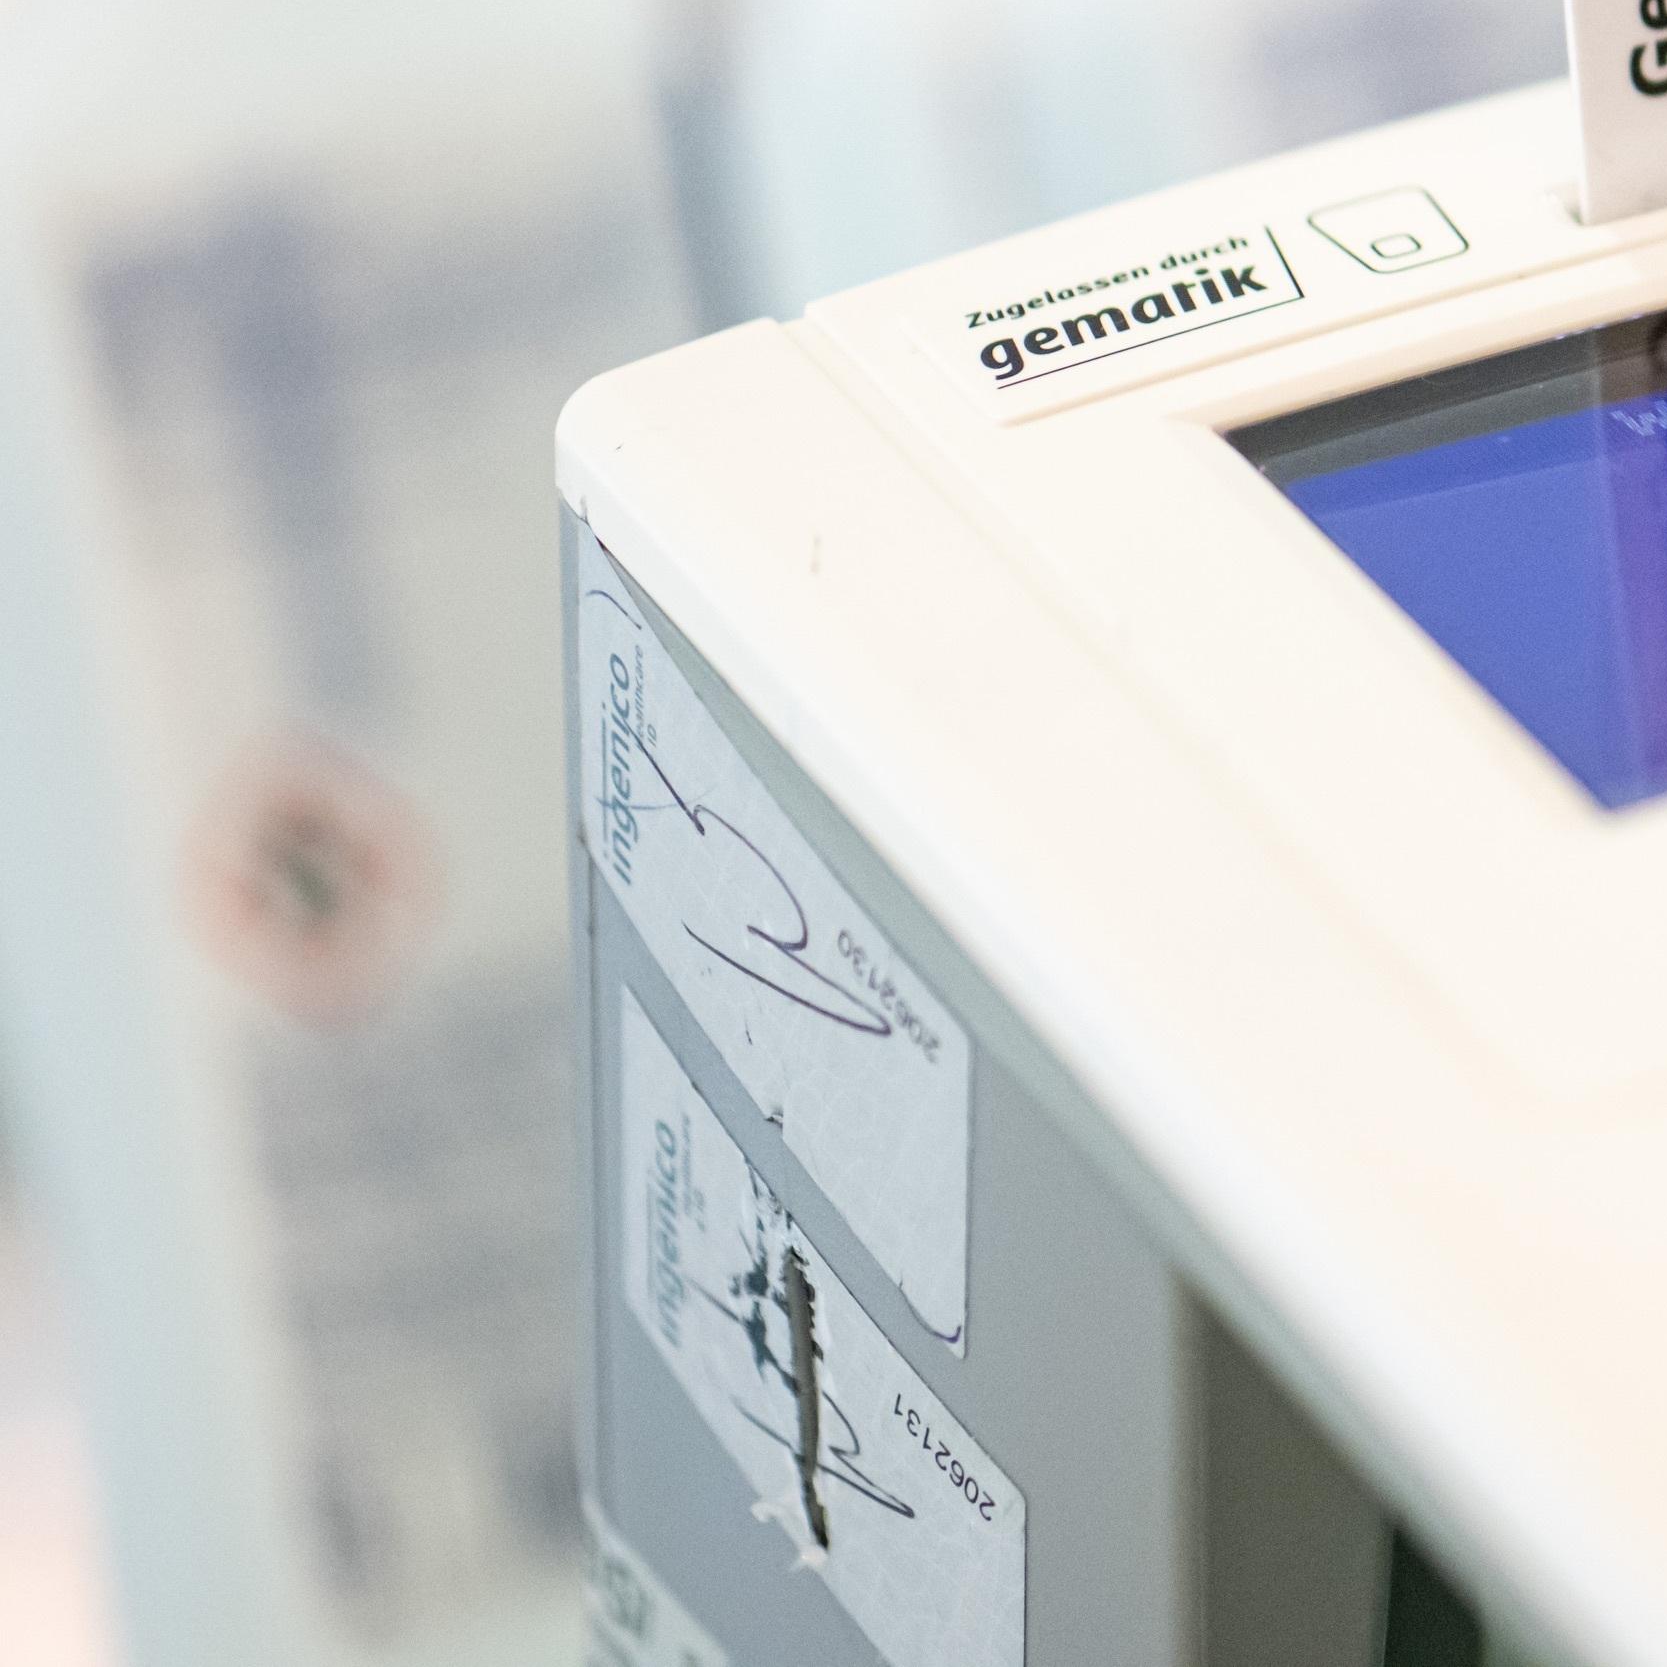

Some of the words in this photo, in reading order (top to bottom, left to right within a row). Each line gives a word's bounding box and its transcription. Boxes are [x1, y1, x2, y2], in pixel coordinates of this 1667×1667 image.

[967, 264, 1149, 328] Zugelassen
[1161, 236, 1249, 272] durch
[980, 263, 1267, 381] gematik
[602, 653, 638, 885] ingenico
[838, 928, 943, 1065] 2062130
[894, 1392, 997, 1523] 2062131
